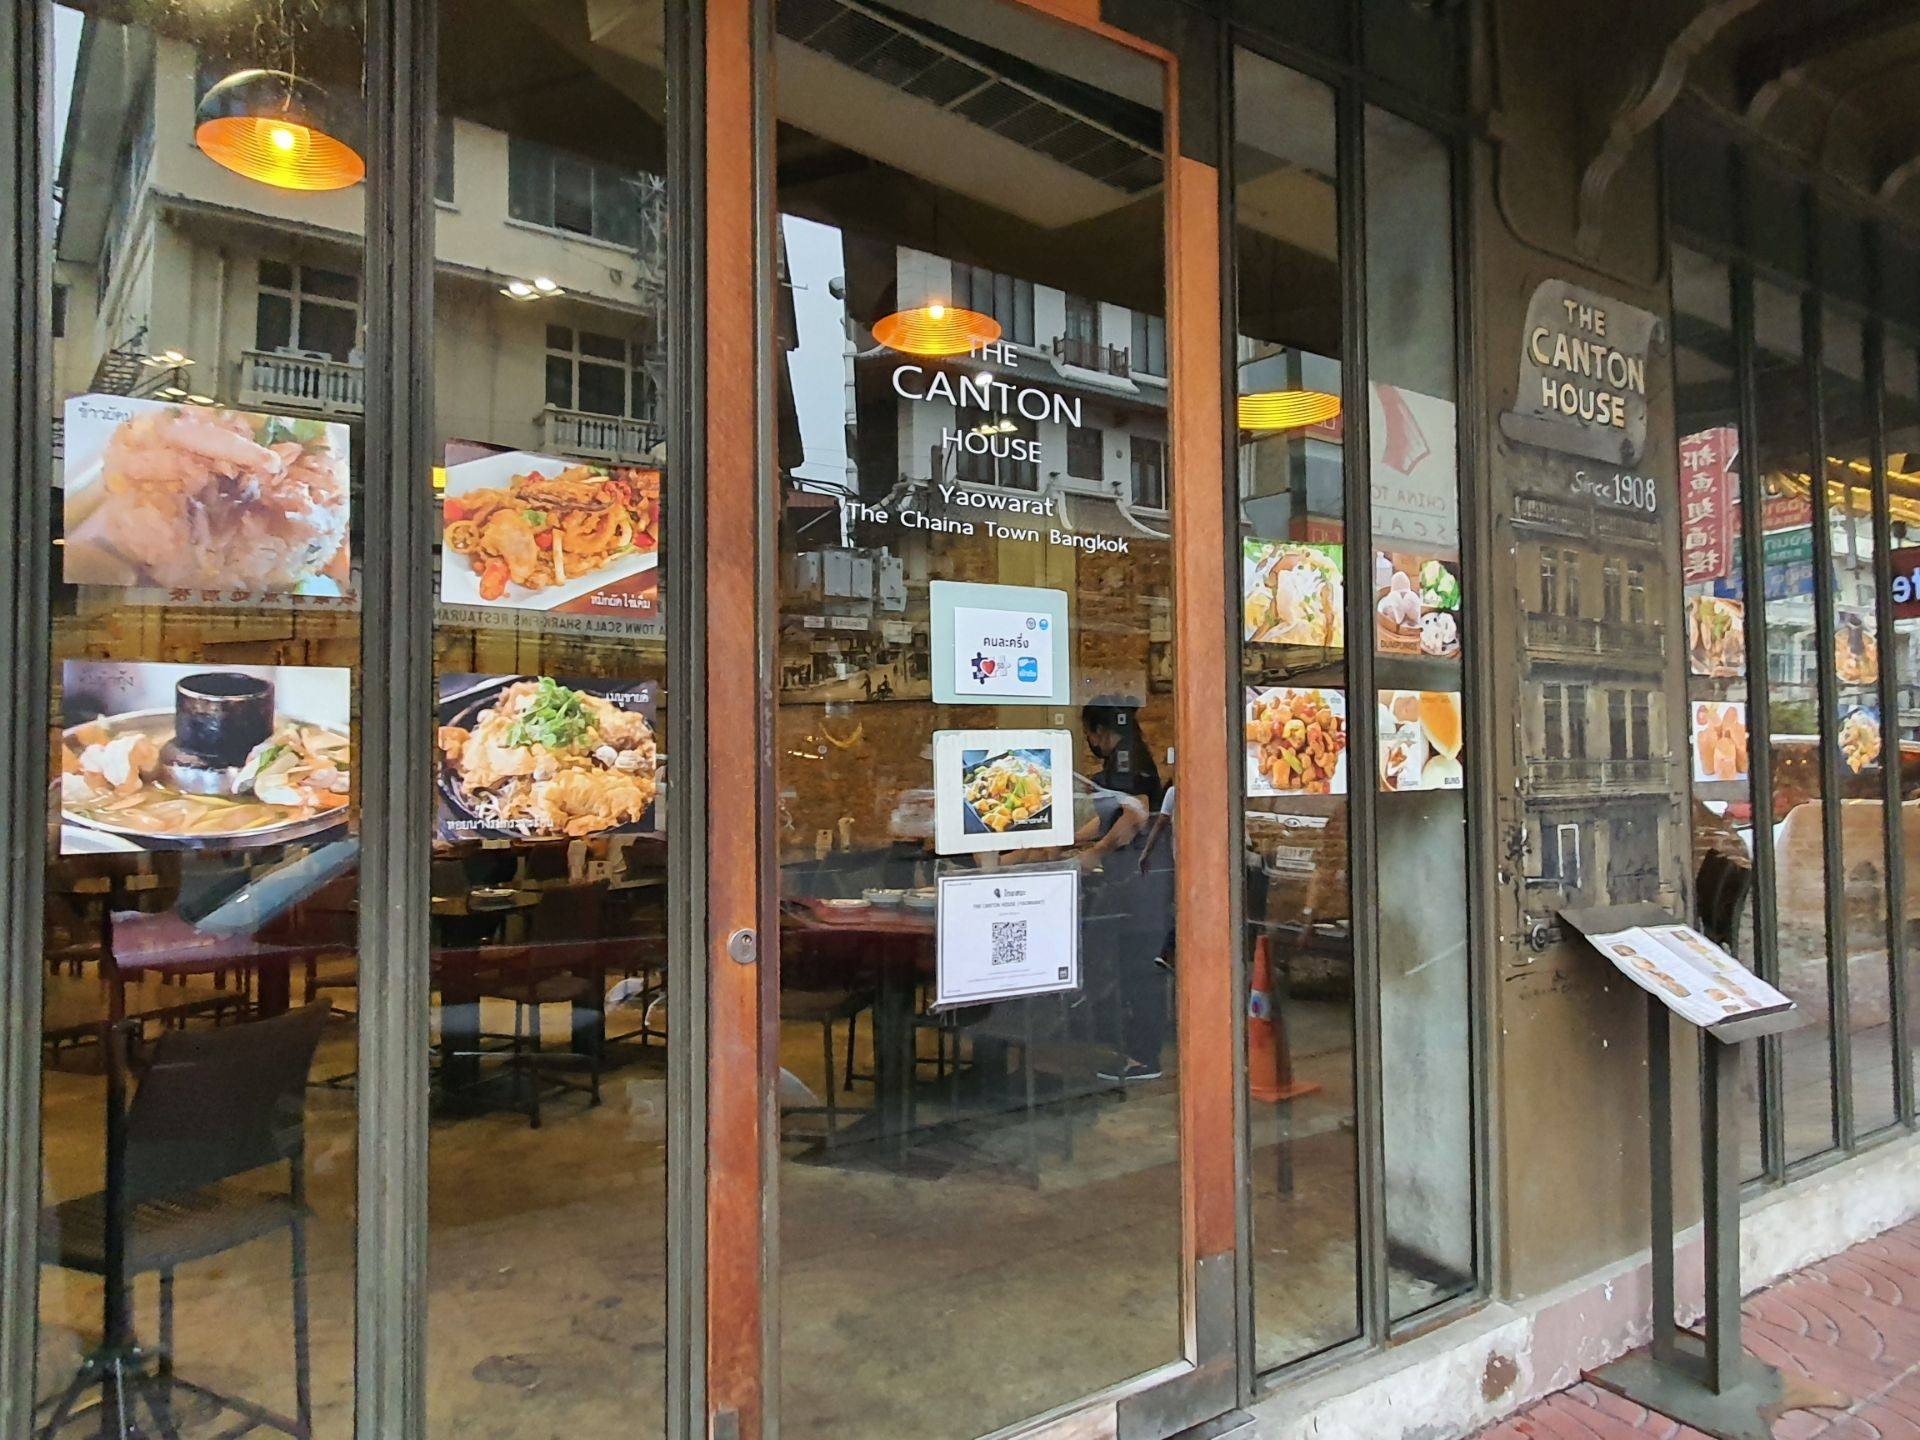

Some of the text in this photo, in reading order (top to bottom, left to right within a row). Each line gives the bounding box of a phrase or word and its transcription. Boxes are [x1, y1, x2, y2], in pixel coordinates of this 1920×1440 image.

[1563, 299, 1606, 337] THE
[966, 334, 1019, 368] THE
[1532, 326, 1645, 395] CANTON
[892, 365, 1082, 429] CANTON
[1541, 376, 1625, 428] HOUSE
[942, 427, 1043, 464] HOUSE
[938, 484, 1055, 518] Yaowarat
[1613, 474, 1657, 513] 1908
[847, 502, 1130, 556] The Chaina Town Bangkok
[983, 633, 1030, 649] คนละครึ่ง
